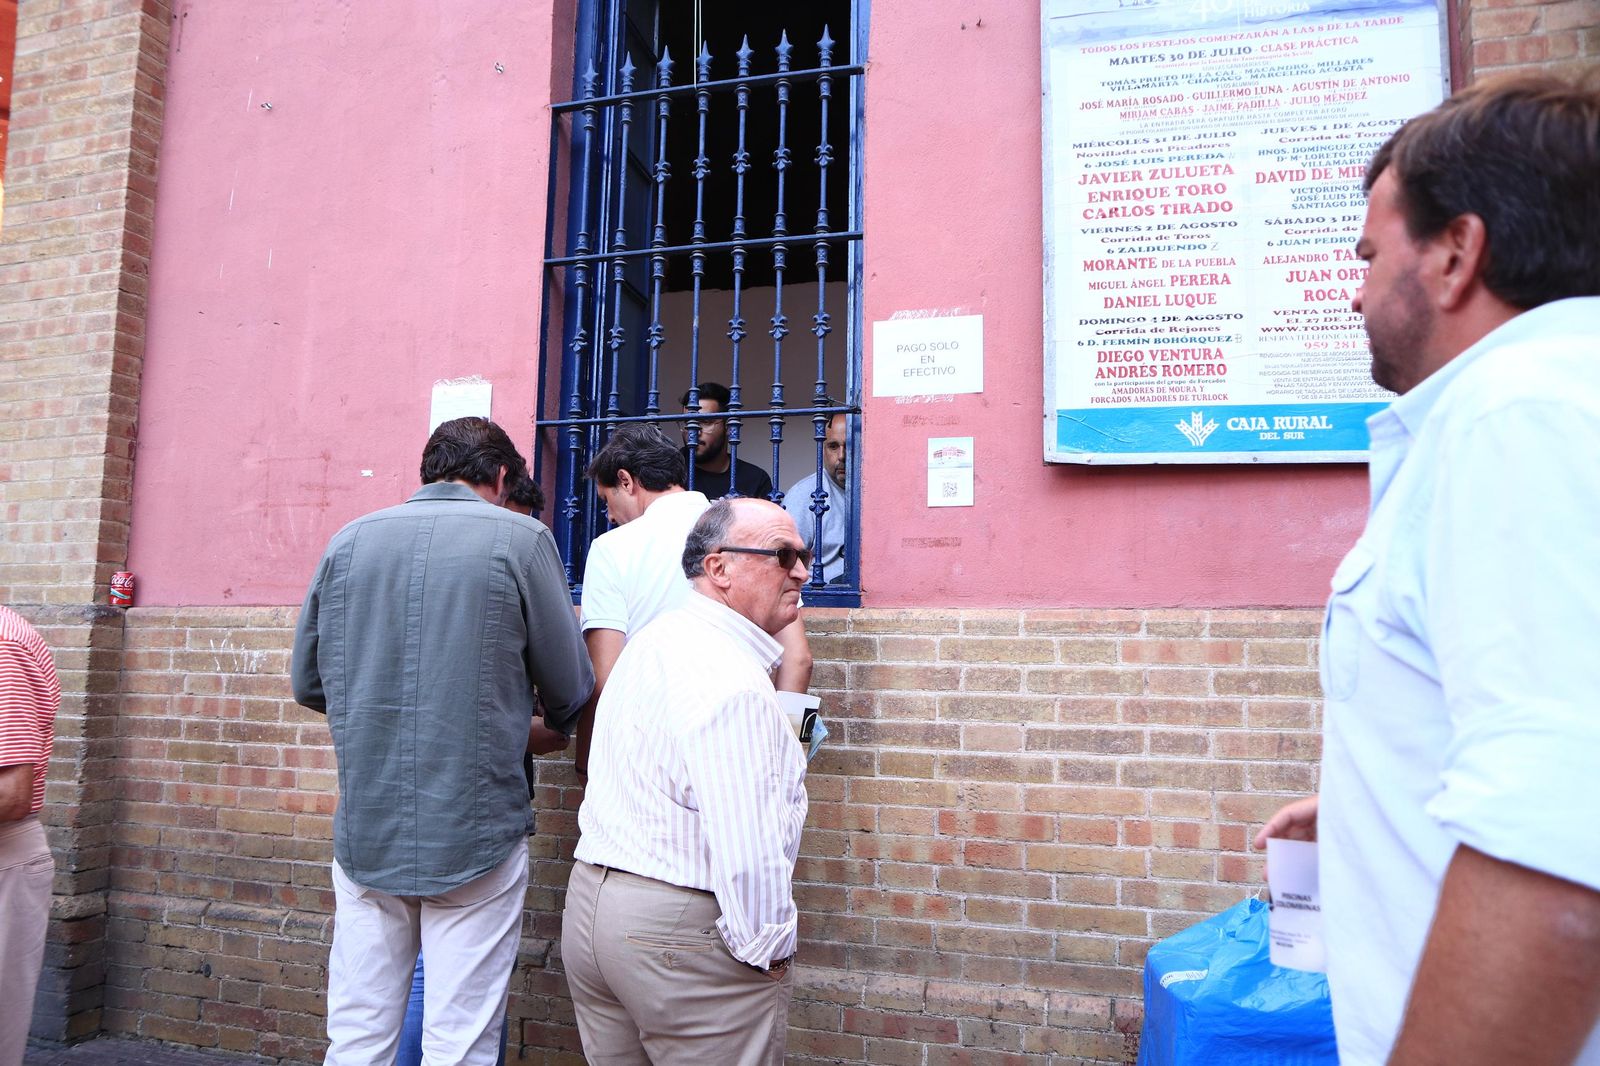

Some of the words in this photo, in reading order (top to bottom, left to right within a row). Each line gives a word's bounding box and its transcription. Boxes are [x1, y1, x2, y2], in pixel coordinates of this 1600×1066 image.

[1080, 45, 1117, 54] TODOS
[1142, 38, 1196, 49] FESTEJOS
[1199, 28, 1278, 44] COMENZARÁN
[1282, 28, 1290, 36] A
[1293, 26, 1314, 34] LAS
[1327, 23, 1342, 31] DE
[1346, 21, 1360, 30] LA
[1363, 16, 1404, 27] TARDE
[1109, 53, 1165, 67] MARTES
[1170, 53, 1184, 62] 30
[1188, 50, 1207, 59] DE
[1210, 46, 1252, 57] JULIO
[1261, 42, 1296, 53] CLASE
[1300, 36, 1358, 50] PRÁCTICA
[1100, 76, 1137, 88] TOMÁS
[1140, 74, 1178, 84] PRIETO
[1196, 71, 1213, 79] LA
[1215, 69, 1237, 77] CAL
[1245, 63, 1308, 75] MACANDRO
[1317, 58, 1374, 68] MILLARES
[1110, 81, 1179, 92] VILLAMARTA
[1187, 76, 1242, 85] CHAMACO
[1250, 69, 1315, 80] MARCELINO
[1319, 64, 1364, 74] ACOSTA
[1080, 100, 1104, 111] JOSÉ
[1106, 96, 1139, 108] MARÍA
[1143, 93, 1184, 105] ROSADO
[1192, 87, 1252, 101] GUILLERMO
[1254, 85, 1283, 97] LUNA
[1292, 79, 1340, 92] AGUSTÍN
[1343, 78, 1357, 88] DE
[1360, 74, 1410, 86] ANTONIO
[1120, 109, 1157, 120] MIRIAM
[1160, 106, 1194, 116] CABAS
[1202, 103, 1234, 114] JAIME
[1237, 97, 1280, 110] PADILLA
[1290, 95, 1320, 106] JULIO
[1323, 91, 1368, 104] MÉNDEZ
[1261, 124, 1317, 134] JUEVES
[1357, 118, 1408, 128] AGOST
[1073, 137, 1149, 150] MIÉRCOLES
[1172, 134, 1191, 142] DE
[1195, 131, 1237, 140] JULIO
[1279, 135, 1332, 143] Corrida
[1076, 148, 1137, 159] Novillada
[1168, 142, 1230, 152] Picadores
[1258, 148, 1289, 156] HNOS.
[1292, 144, 1356, 154] DOMÍNGUEZ
[1305, 152, 1346, 160] LORETO
[1095, 159, 1129, 168] JOSÉ
[1133, 157, 1164, 165] LUIS
[1168, 152, 1224, 163] PEREDA
[1078, 170, 1143, 186] JAVIER
[1149, 163, 1234, 181] ZULUETA
[1256, 170, 1306, 184] DAVID
[1312, 167, 1333, 180] DE
[1338, 165, 1366, 178] MIR
[1088, 186, 1170, 204] ENRIQUE
[1175, 182, 1227, 196] TORO
[1291, 186, 1349, 194] VICTORINO
[1294, 193, 1320, 202] JOSÉ
[1083, 205, 1155, 220] CARLOS
[1160, 200, 1234, 216] TIRADO
[1292, 201, 1347, 210] SANTIAGO
[1264, 216, 1325, 225] SÁBADO
[1081, 224, 1142, 234] VIERNES
[1180, 221, 1238, 230] AGOSTO
[1101, 234, 1151, 244] Corrida
[1118, 243, 1207, 254] ZALDUENDO
[1083, 257, 1157, 272] MORANTE
[1162, 259, 1175, 268] DE
[1178, 259, 1191, 268] LA
[1195, 257, 1236, 267] PUEBLA
[1263, 253, 1329, 264] ALEJANDRO
[1088, 280, 1128, 290] MIGUEL
[1131, 278, 1166, 288] ÁNGEL
[1170, 273, 1231, 286] PERERA
[1286, 270, 1332, 282] JUAN
[1337, 268, 1369, 280] ORT
[1103, 295, 1160, 309] DANIEL
[1165, 292, 1217, 308] LUQUE
[1304, 289, 1350, 301] ROCA
[1079, 317, 1146, 326] DOMINGO
[1185, 313, 1244, 322] AGOSTO
[1096, 327, 1146, 336] Corrida
[1169, 325, 1221, 334] Rejones
[1261, 324, 1365, 332] WWW.TOROSPE
[897, 343, 926, 352] PAGO
[930, 341, 959, 351] SOLO
[1103, 336, 1150, 346] FERMÍN
[1154, 335, 1232, 344] BOHÓRQUEZ
[1304, 341, 1328, 349] 959
[1334, 340, 1357, 348] 281
[921, 355, 935, 364] EN
[1097, 350, 1144, 363] DIEGO
[1148, 348, 1224, 362] VENTURA
[904, 366, 956, 377] EFECTIVO
[1095, 363, 1157, 379] ANDRÉS
[1162, 363, 1227, 377] ROMERO
[1191, 393, 1228, 401] TURLOCK
[1226, 417, 1271, 432] CAJA
[1273, 415, 1333, 430] RURAL
